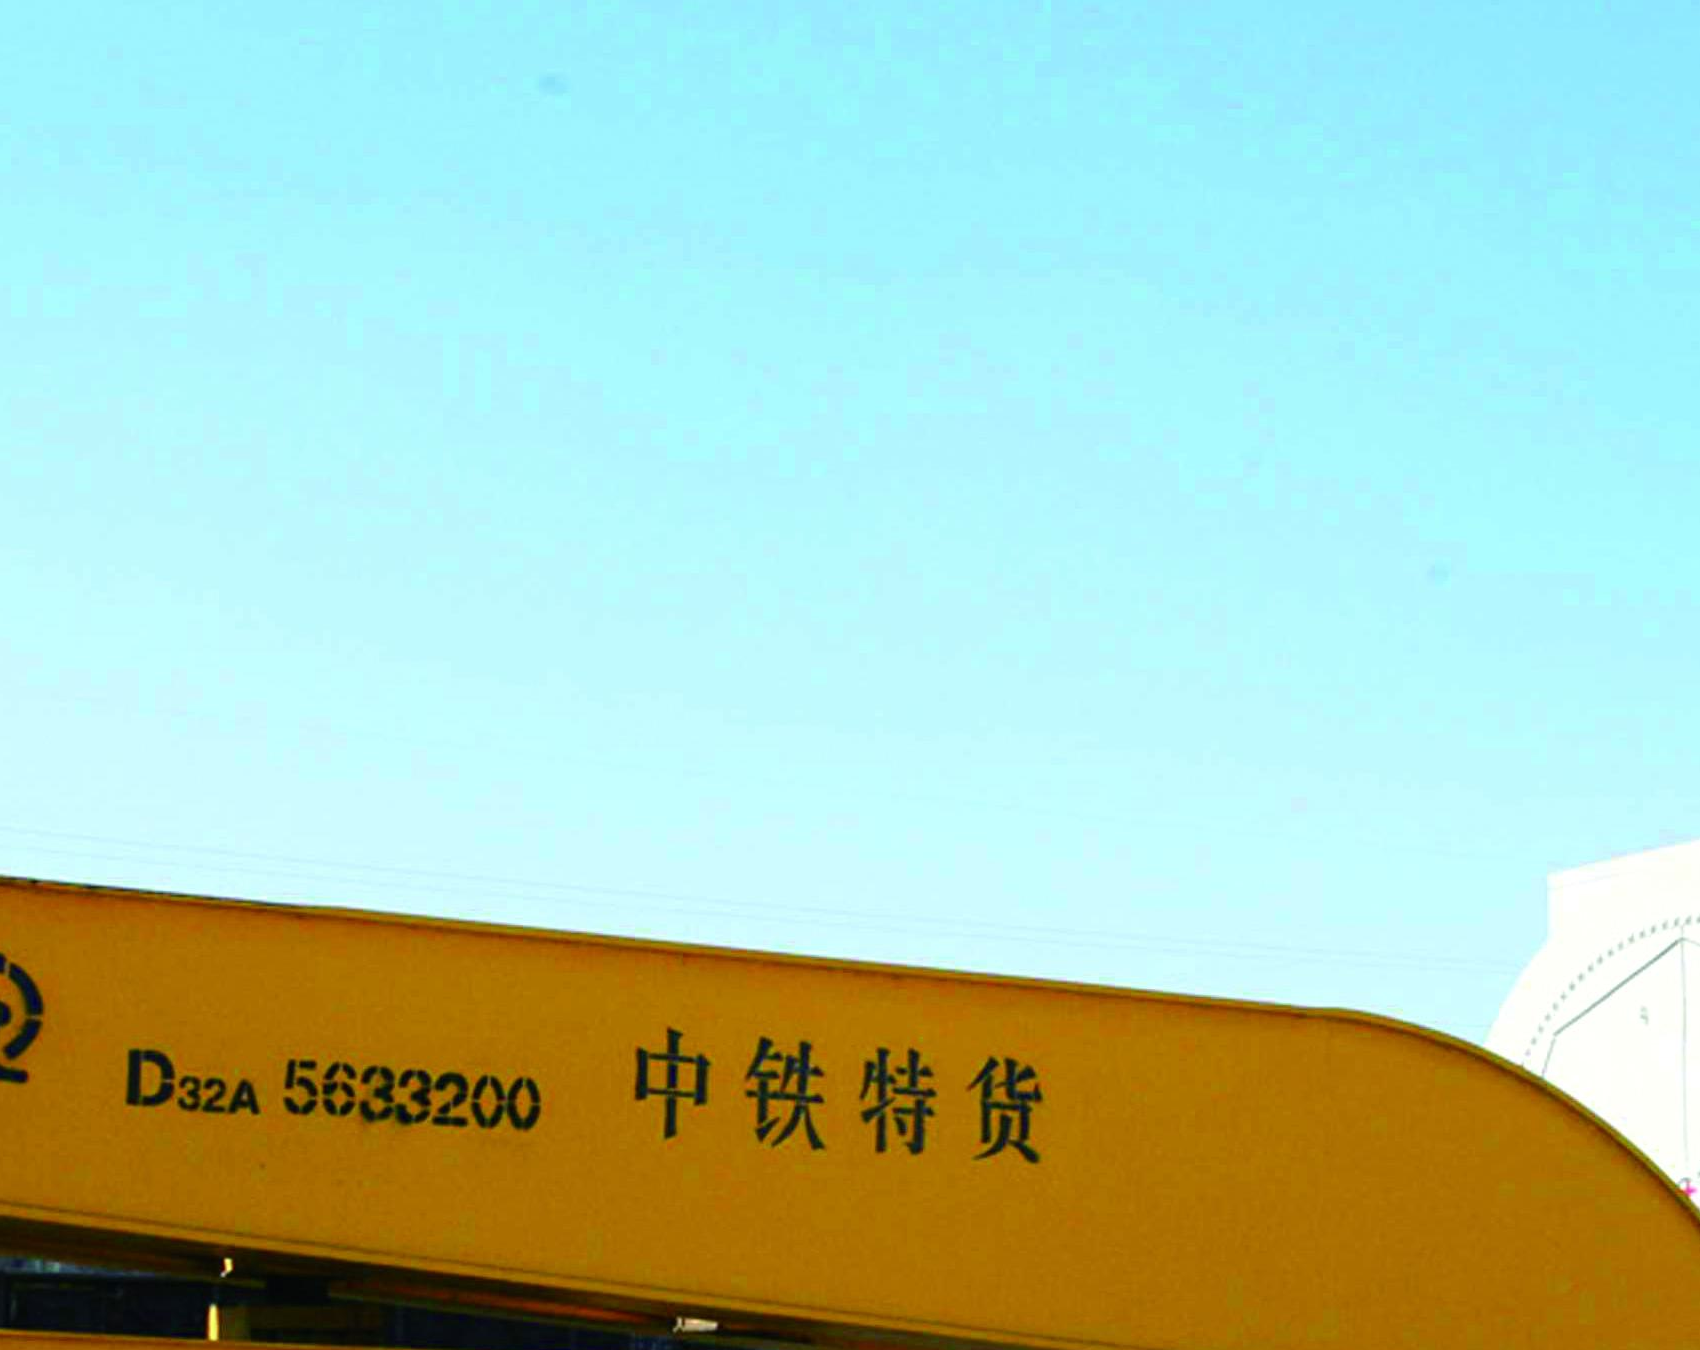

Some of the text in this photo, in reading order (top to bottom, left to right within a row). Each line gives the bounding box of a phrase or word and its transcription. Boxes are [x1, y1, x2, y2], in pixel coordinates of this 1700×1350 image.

[125, 1048, 542, 1131] D32A 5633200
[634, 1027, 1044, 1164] 中铁特货
